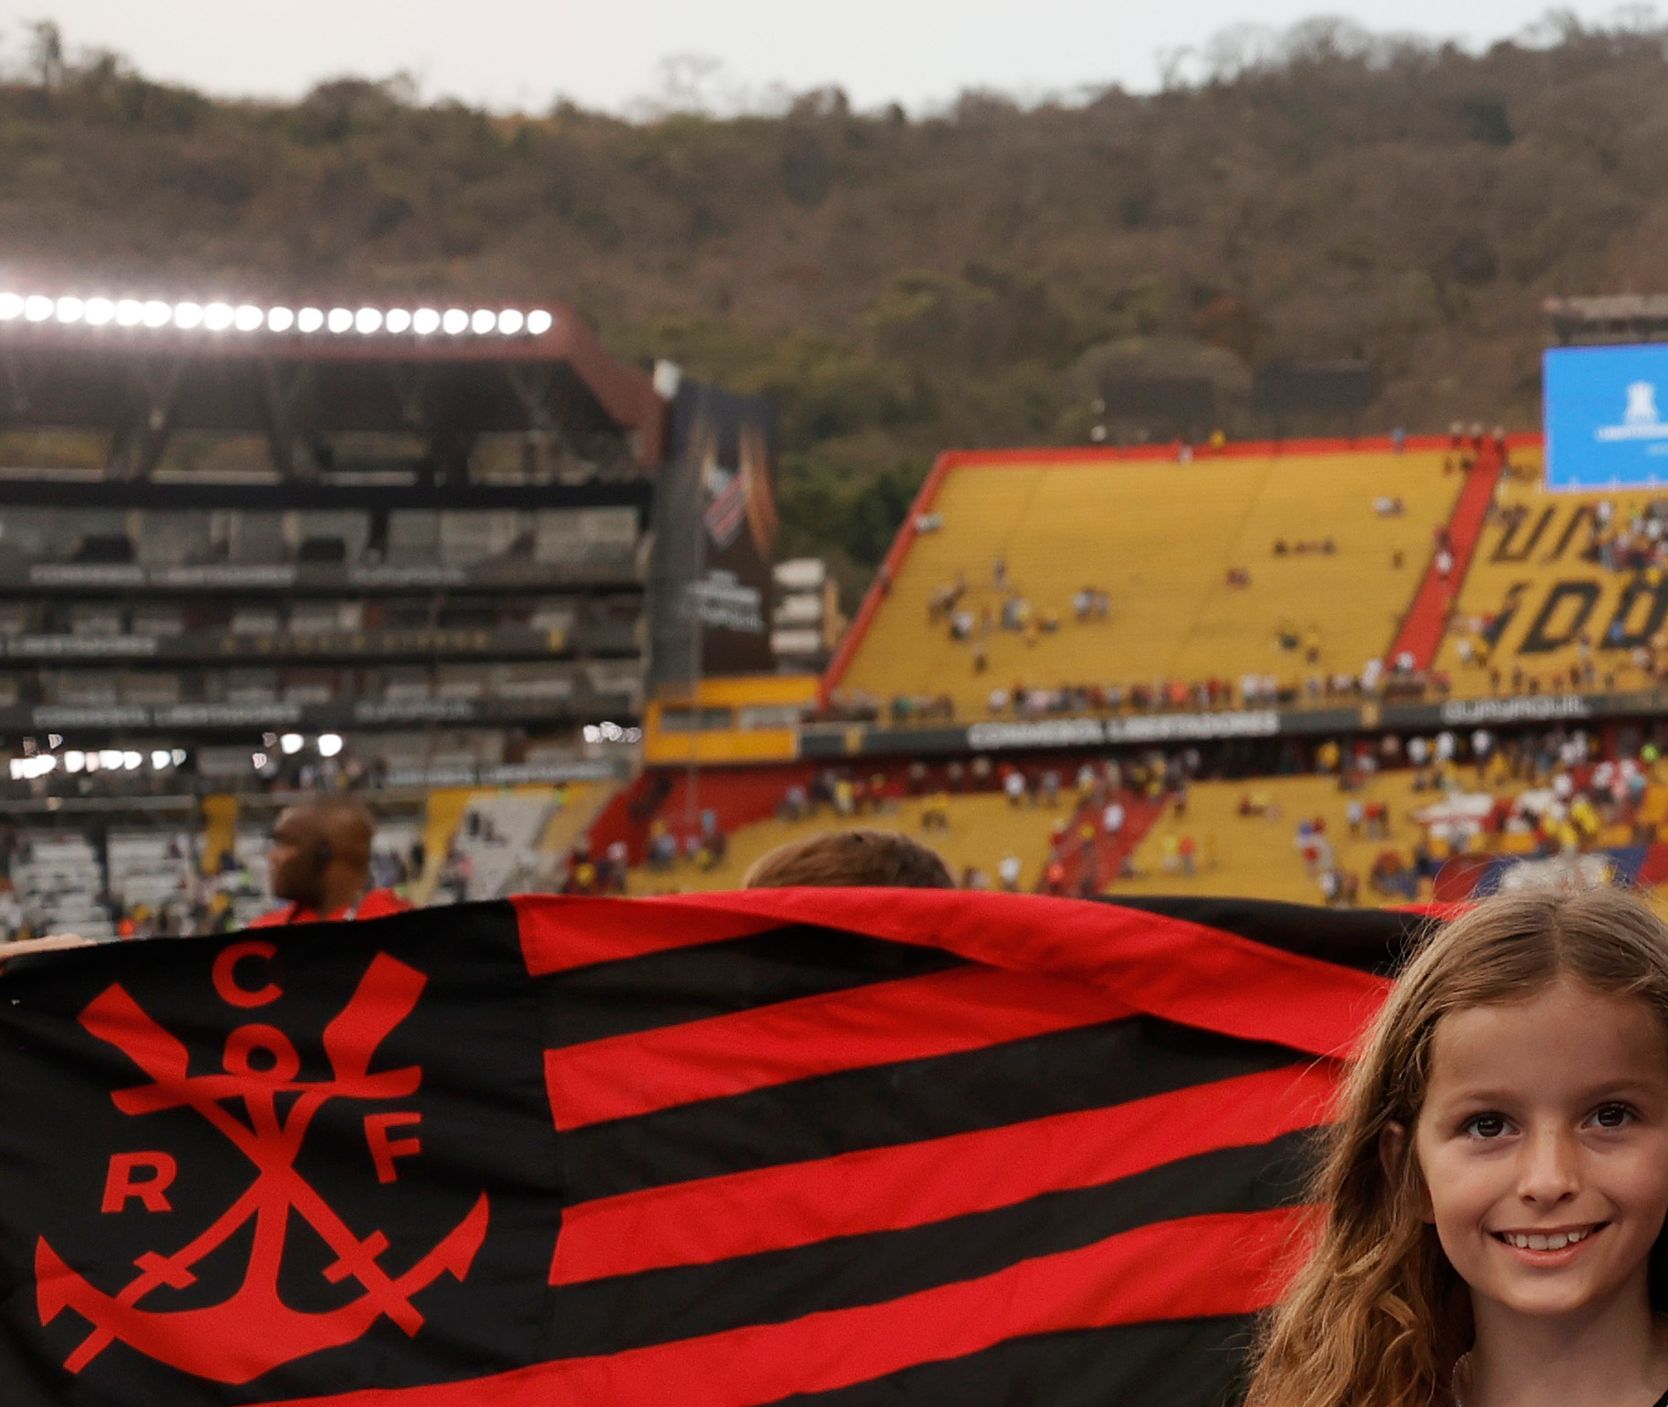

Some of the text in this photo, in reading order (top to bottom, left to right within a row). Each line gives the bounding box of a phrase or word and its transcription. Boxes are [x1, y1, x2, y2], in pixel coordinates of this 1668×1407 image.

[211, 941, 285, 1008] C
[100, 1111, 424, 1214] R F
